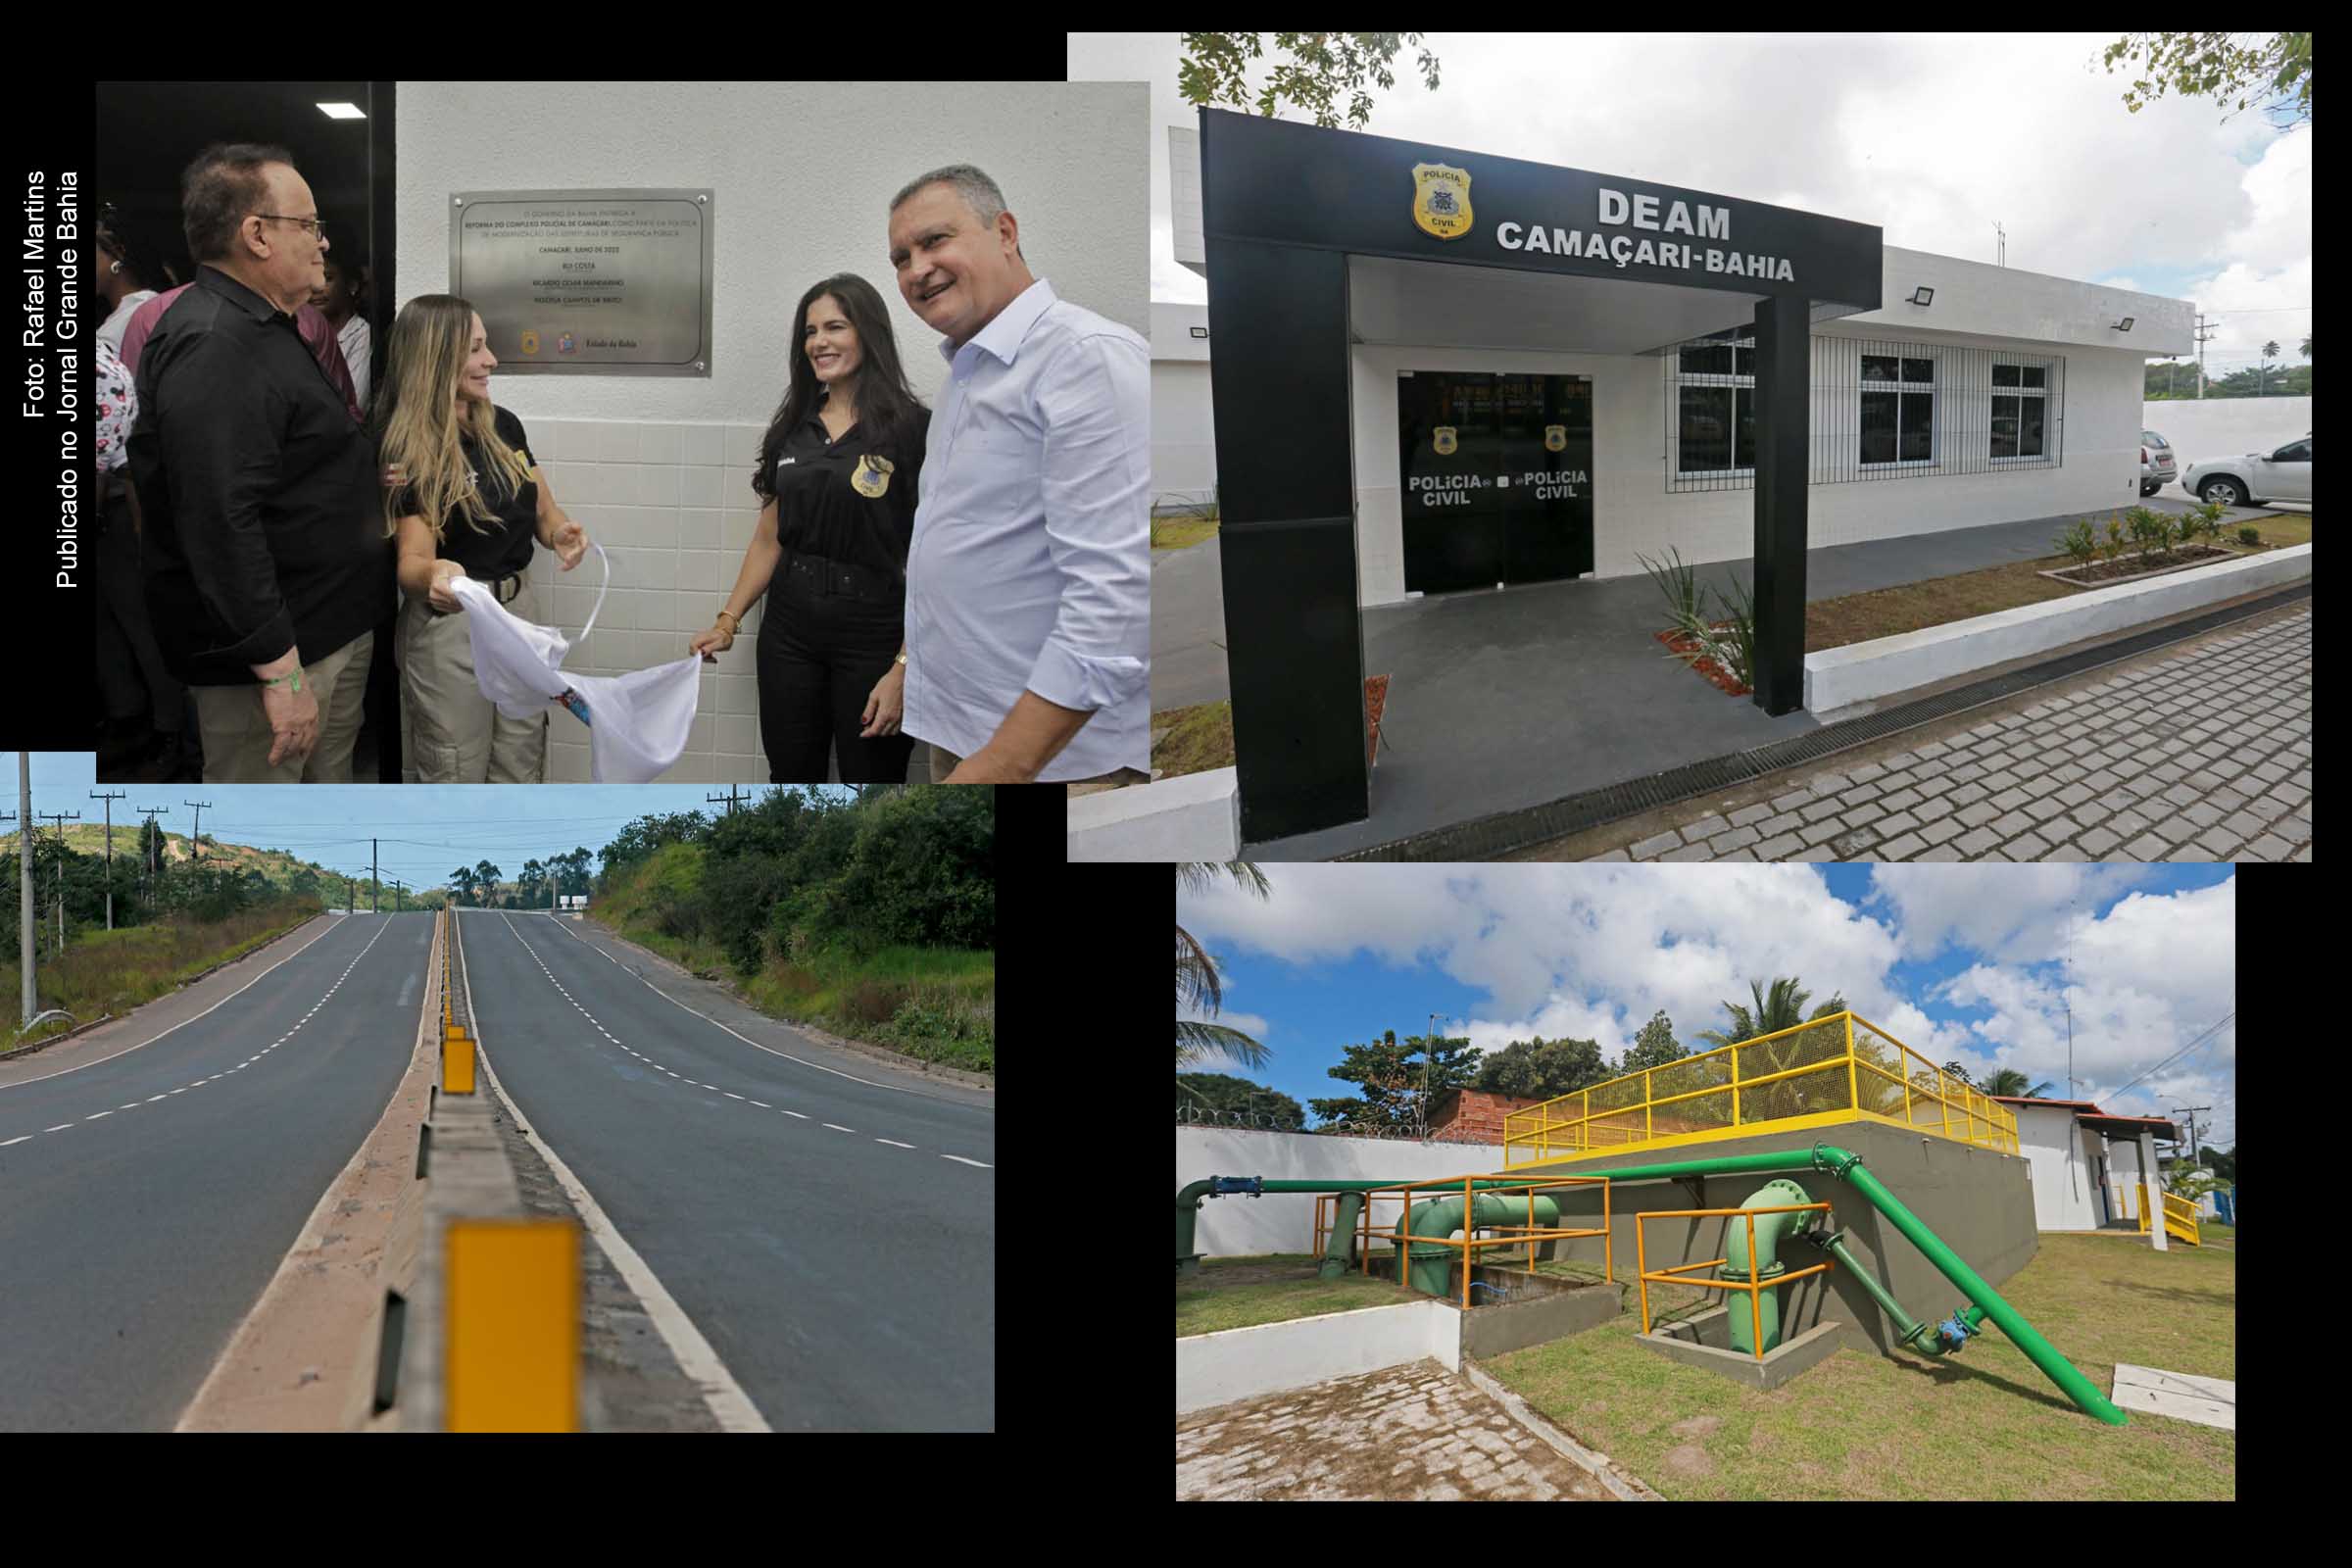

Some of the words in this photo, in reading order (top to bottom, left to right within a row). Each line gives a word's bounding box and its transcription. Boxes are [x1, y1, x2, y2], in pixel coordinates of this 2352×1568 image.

[1598, 187, 1731, 241] DEAM
[1422, 490, 1471, 507] CIVIL
[1536, 485, 1578, 500] CIVIL
